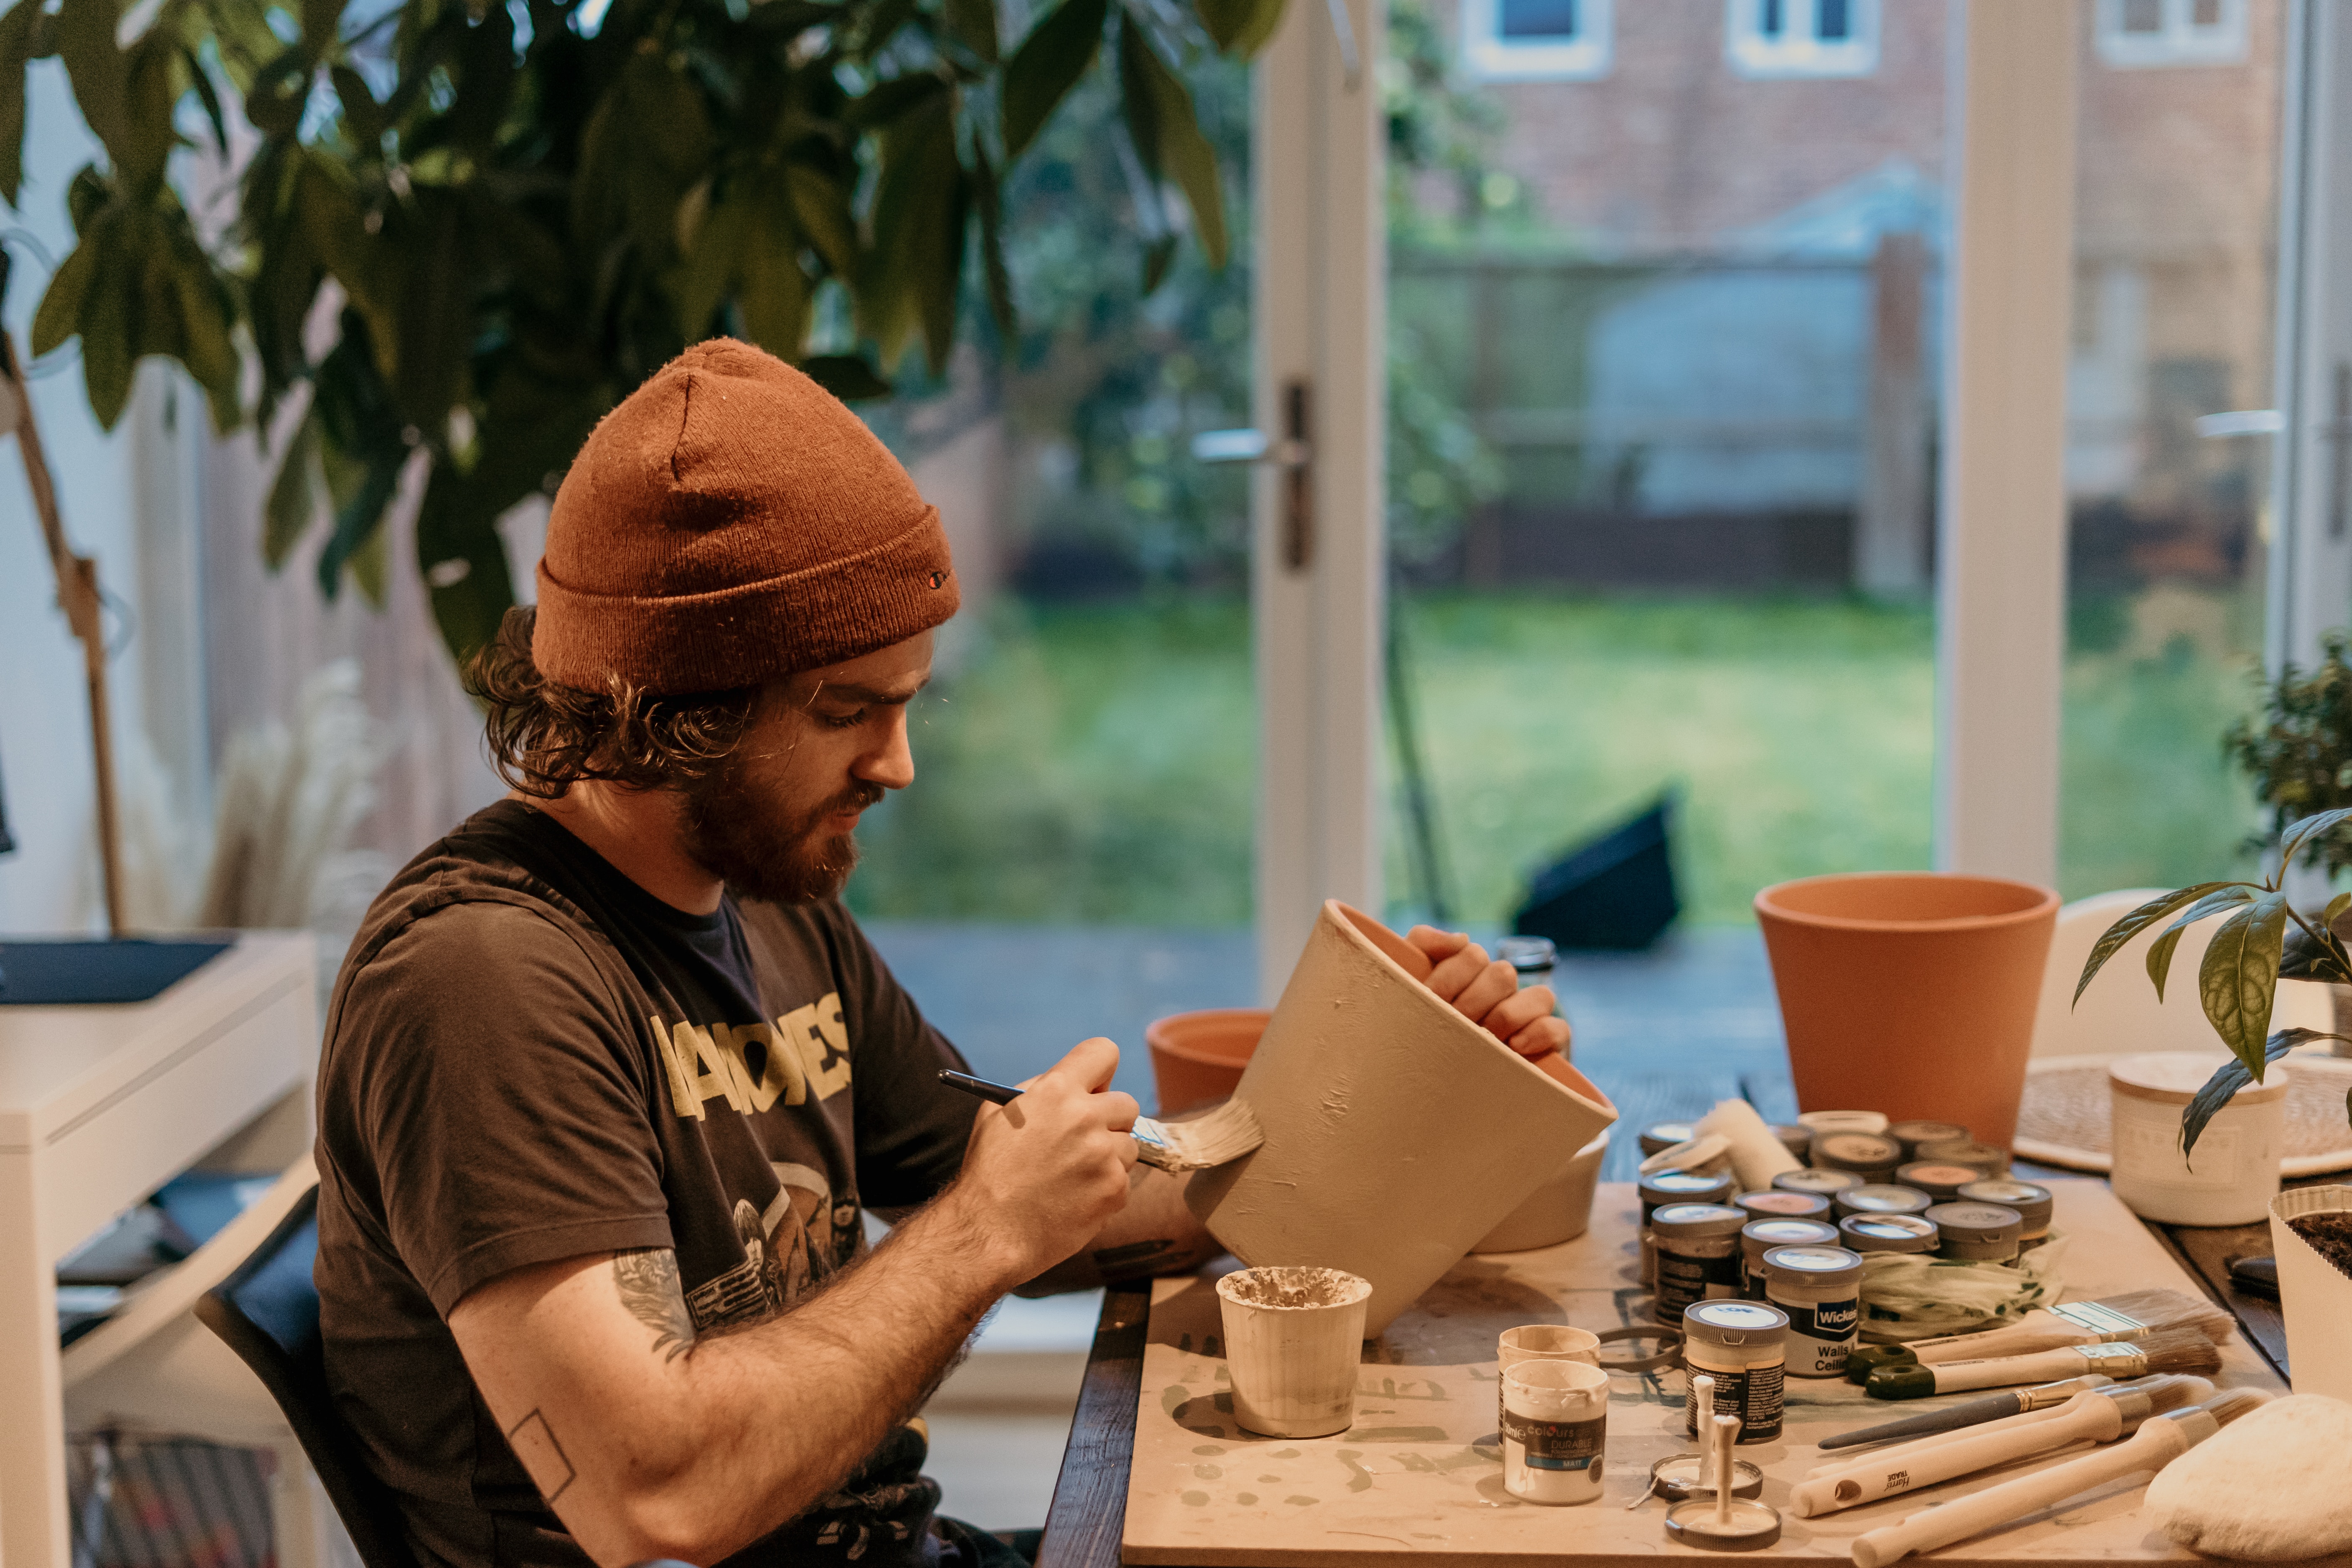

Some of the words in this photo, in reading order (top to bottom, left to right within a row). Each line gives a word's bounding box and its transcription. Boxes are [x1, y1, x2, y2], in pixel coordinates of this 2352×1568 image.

[1819, 1309, 1857, 1324] Wickes
[1818, 1345, 1849, 1357] Walls
[1527, 1425, 1574, 1438] colours
[1551, 1438, 1593, 1449] DURABLE
[1887, 1470, 1908, 1482] TRADE
[1884, 1476, 1910, 1492] Harris
